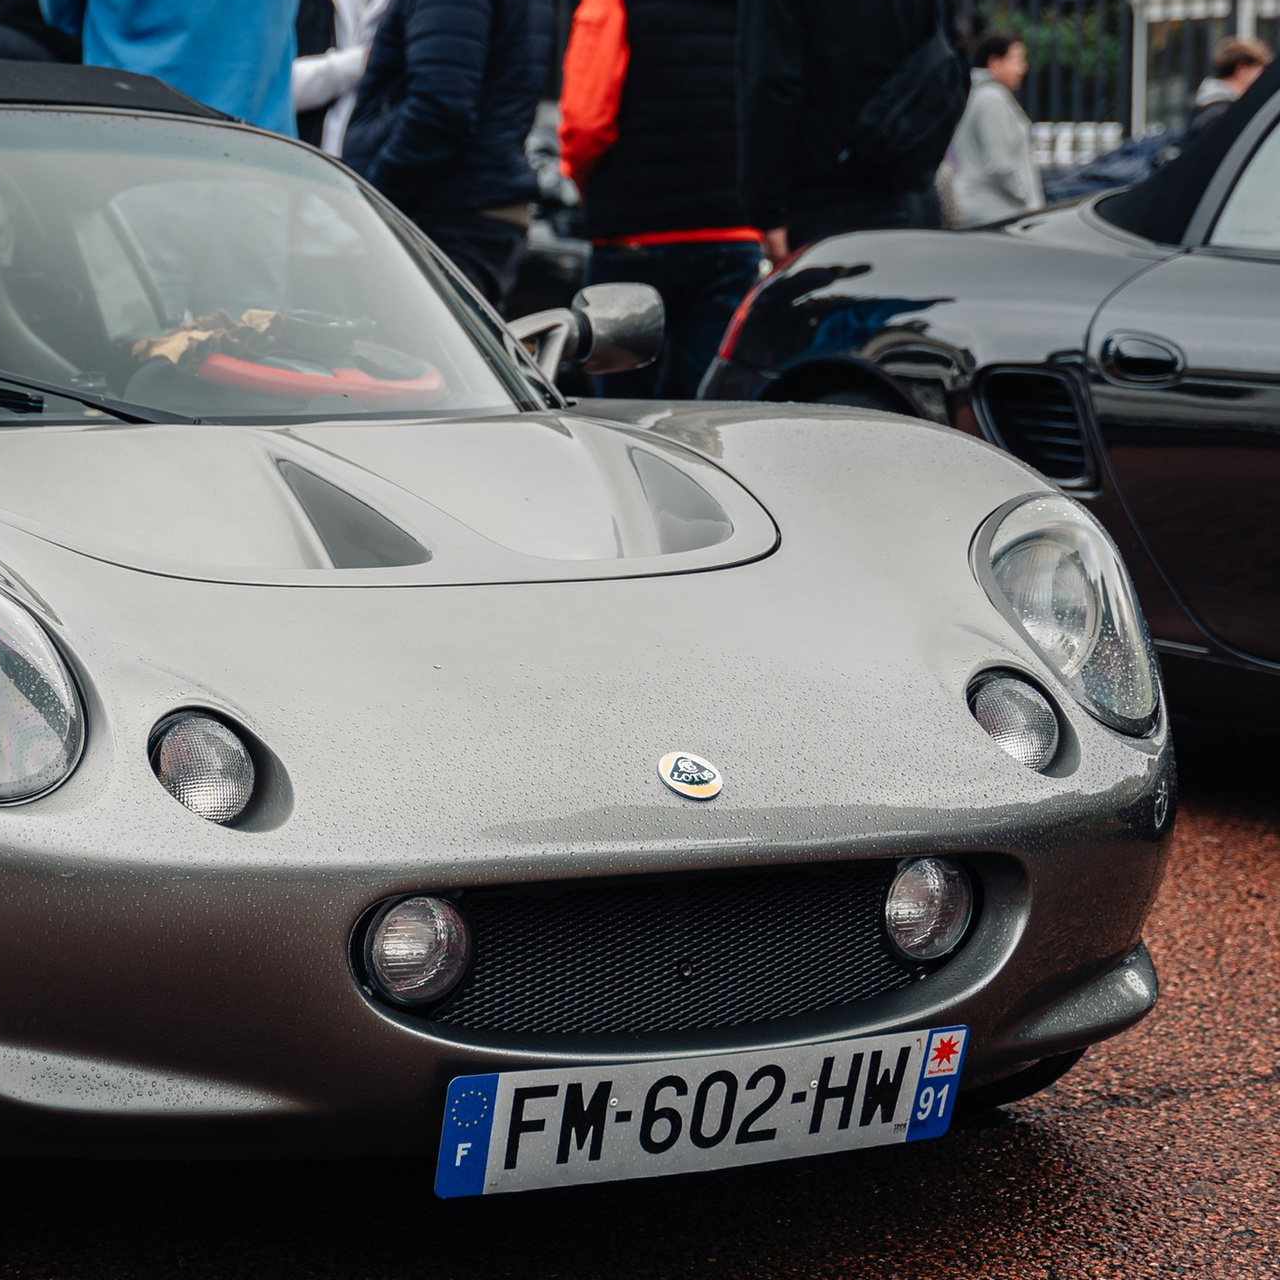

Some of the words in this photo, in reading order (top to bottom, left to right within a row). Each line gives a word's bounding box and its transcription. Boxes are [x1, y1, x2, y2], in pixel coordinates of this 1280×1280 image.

[673, 770, 714, 781] LOTUS
[503, 1046, 911, 1170] FM-602-HW
[917, 1084, 950, 1120] 91
[455, 1142, 472, 1167] F
